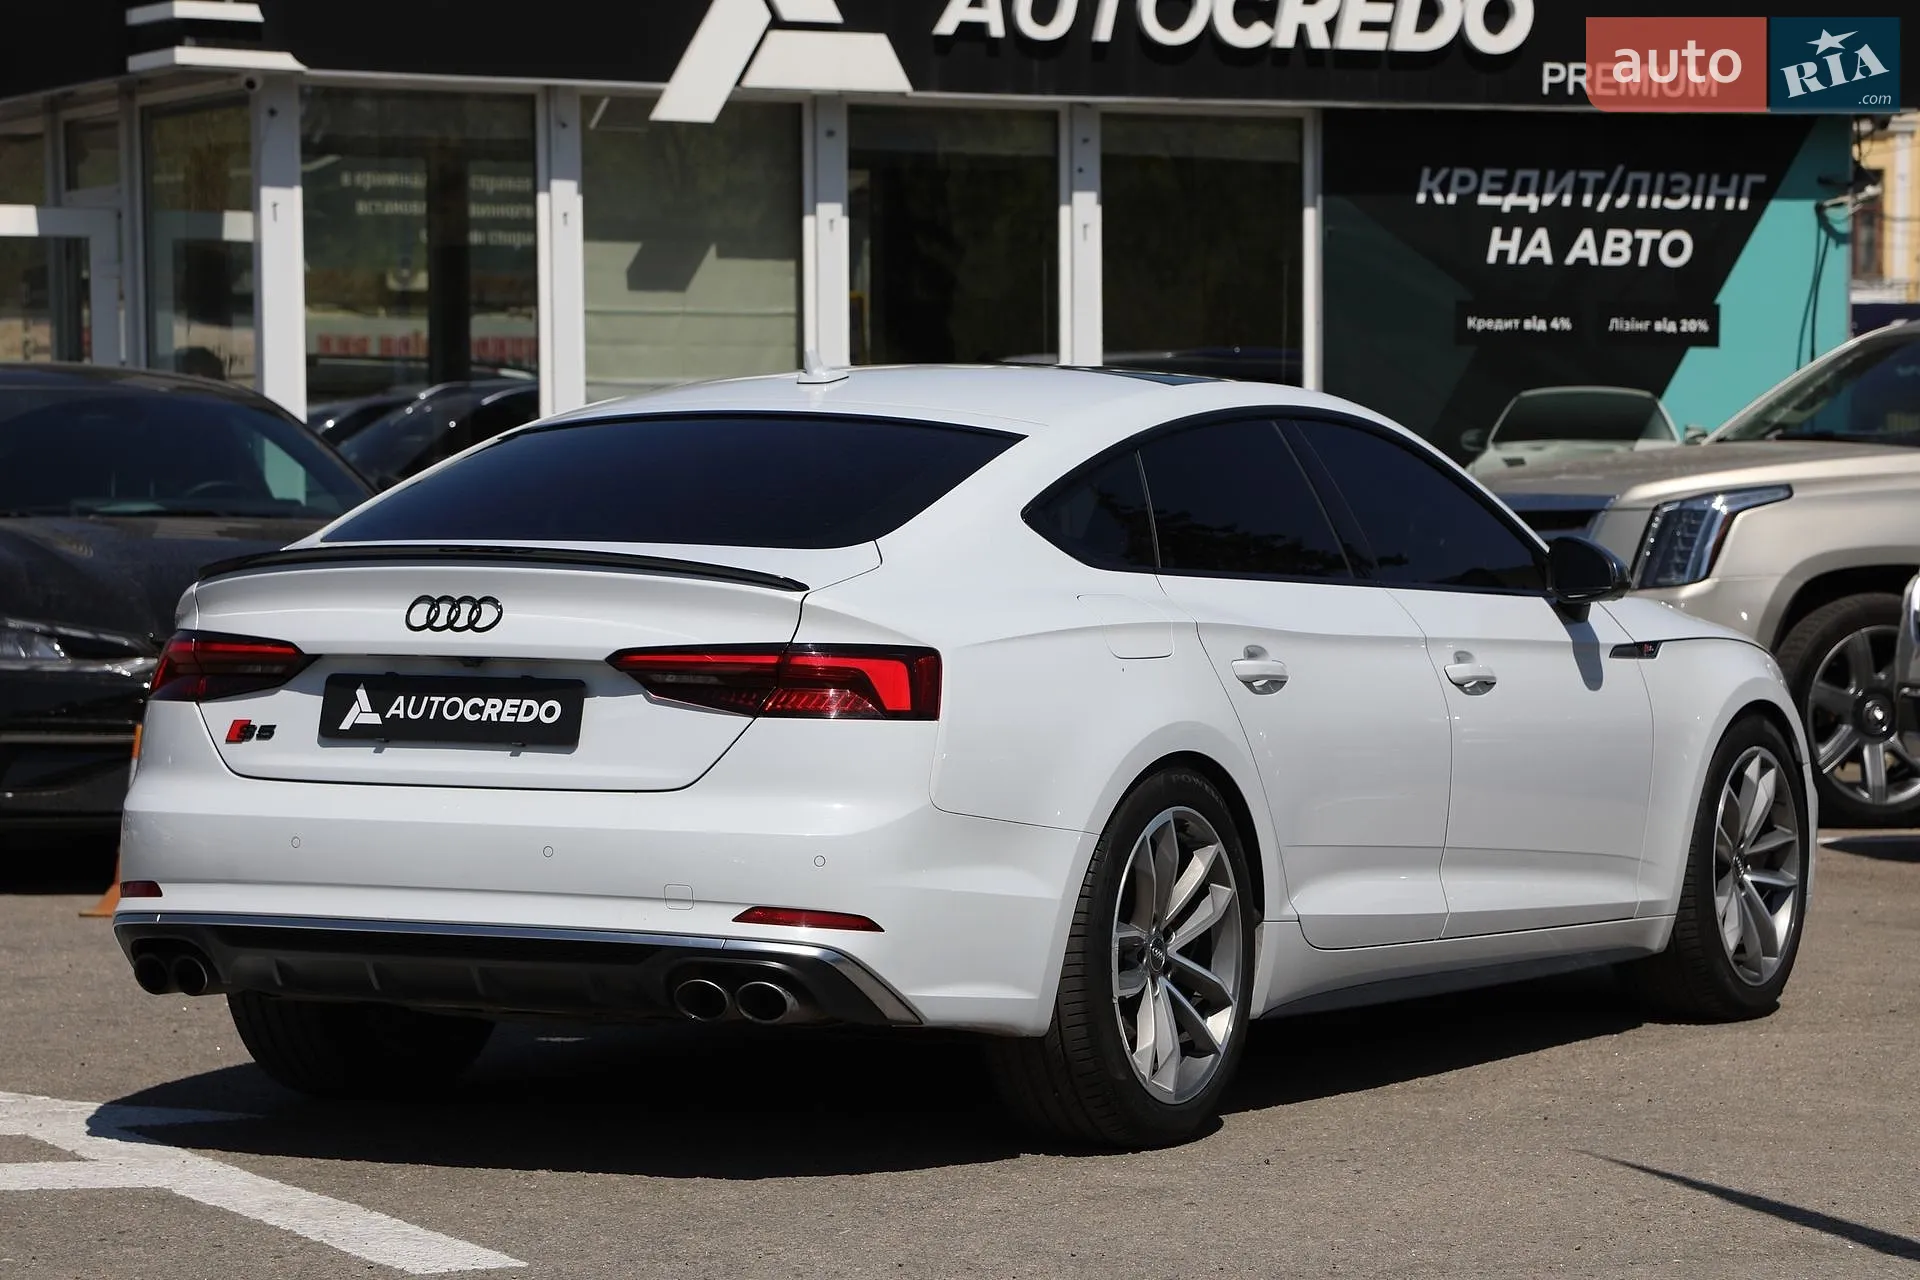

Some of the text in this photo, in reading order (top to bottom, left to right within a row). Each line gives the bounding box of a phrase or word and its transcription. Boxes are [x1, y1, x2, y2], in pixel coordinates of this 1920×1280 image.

[1415, 165, 1767, 213] КРЕДИТ/ЛІЗІНГ
[1486, 226, 1694, 268] НА АВТО
[1467, 315, 1573, 332] Кредит від 4%
[1608, 317, 1709, 333] Лізінг від 20%
[385, 695, 562, 724] AUTOCREDO
[231, 722, 277, 743] S5
